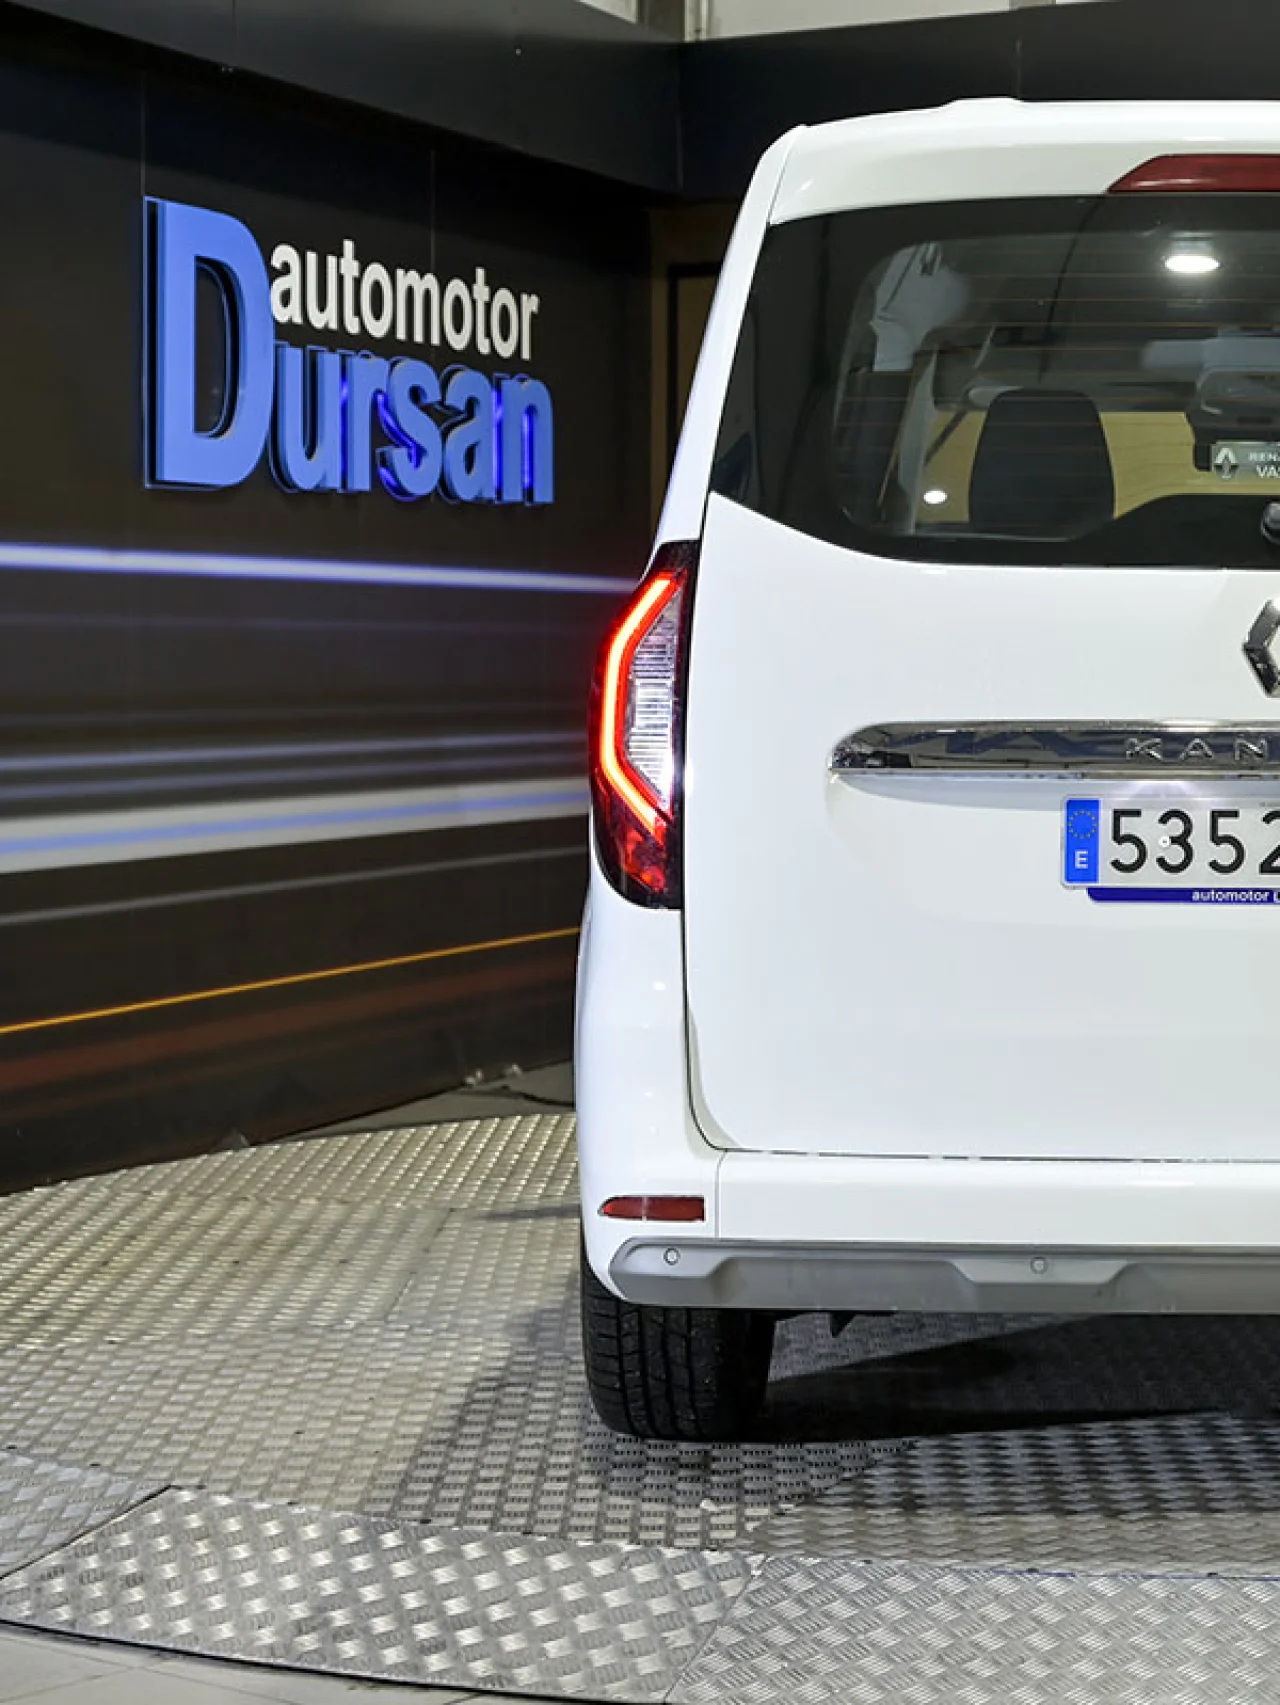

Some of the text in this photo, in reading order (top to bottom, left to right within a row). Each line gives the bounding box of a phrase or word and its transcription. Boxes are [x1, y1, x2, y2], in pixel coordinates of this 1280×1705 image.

[270, 239, 540, 360] automotor
[143, 195, 554, 506] Dursan
[1074, 850, 1089, 870] E
[1192, 889, 1269, 902] automotor
